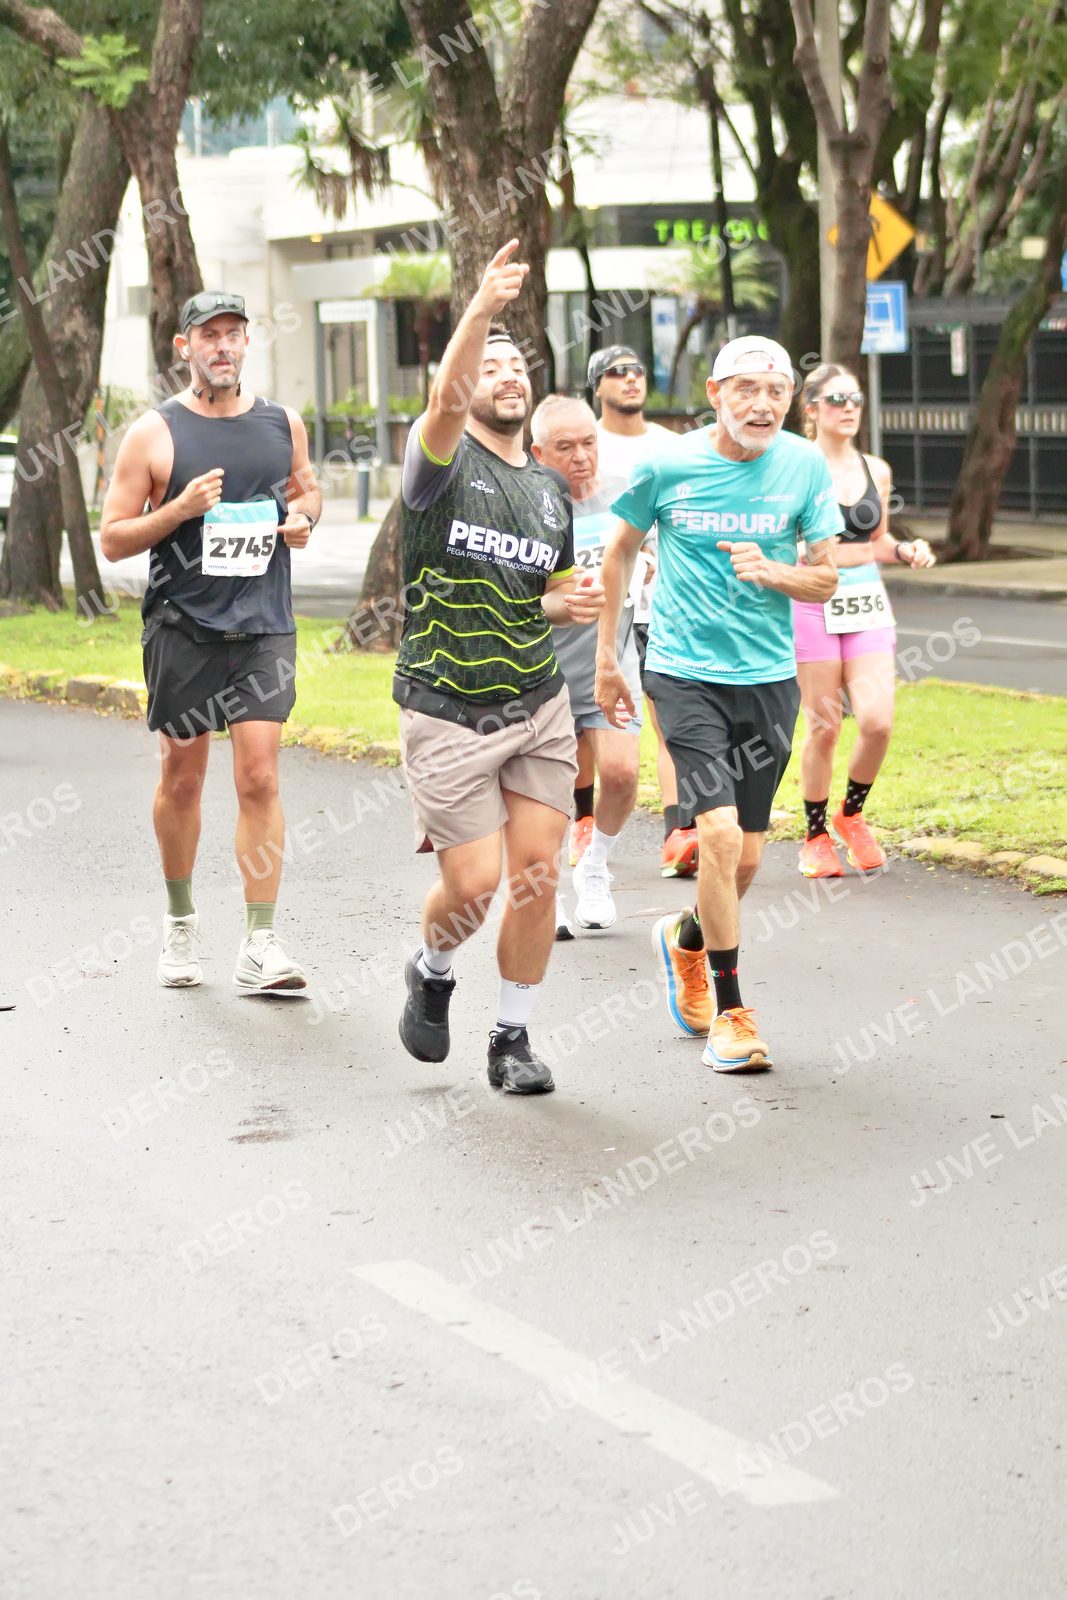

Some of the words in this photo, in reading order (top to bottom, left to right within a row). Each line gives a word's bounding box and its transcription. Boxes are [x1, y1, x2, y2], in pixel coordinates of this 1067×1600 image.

[671, 509, 789, 534] PERDURA
[209, 534, 274, 558] 2745
[446, 546, 466, 557] PEGA
[466, 551, 488, 562] PISOS
[830, 594, 885, 616] 5536
